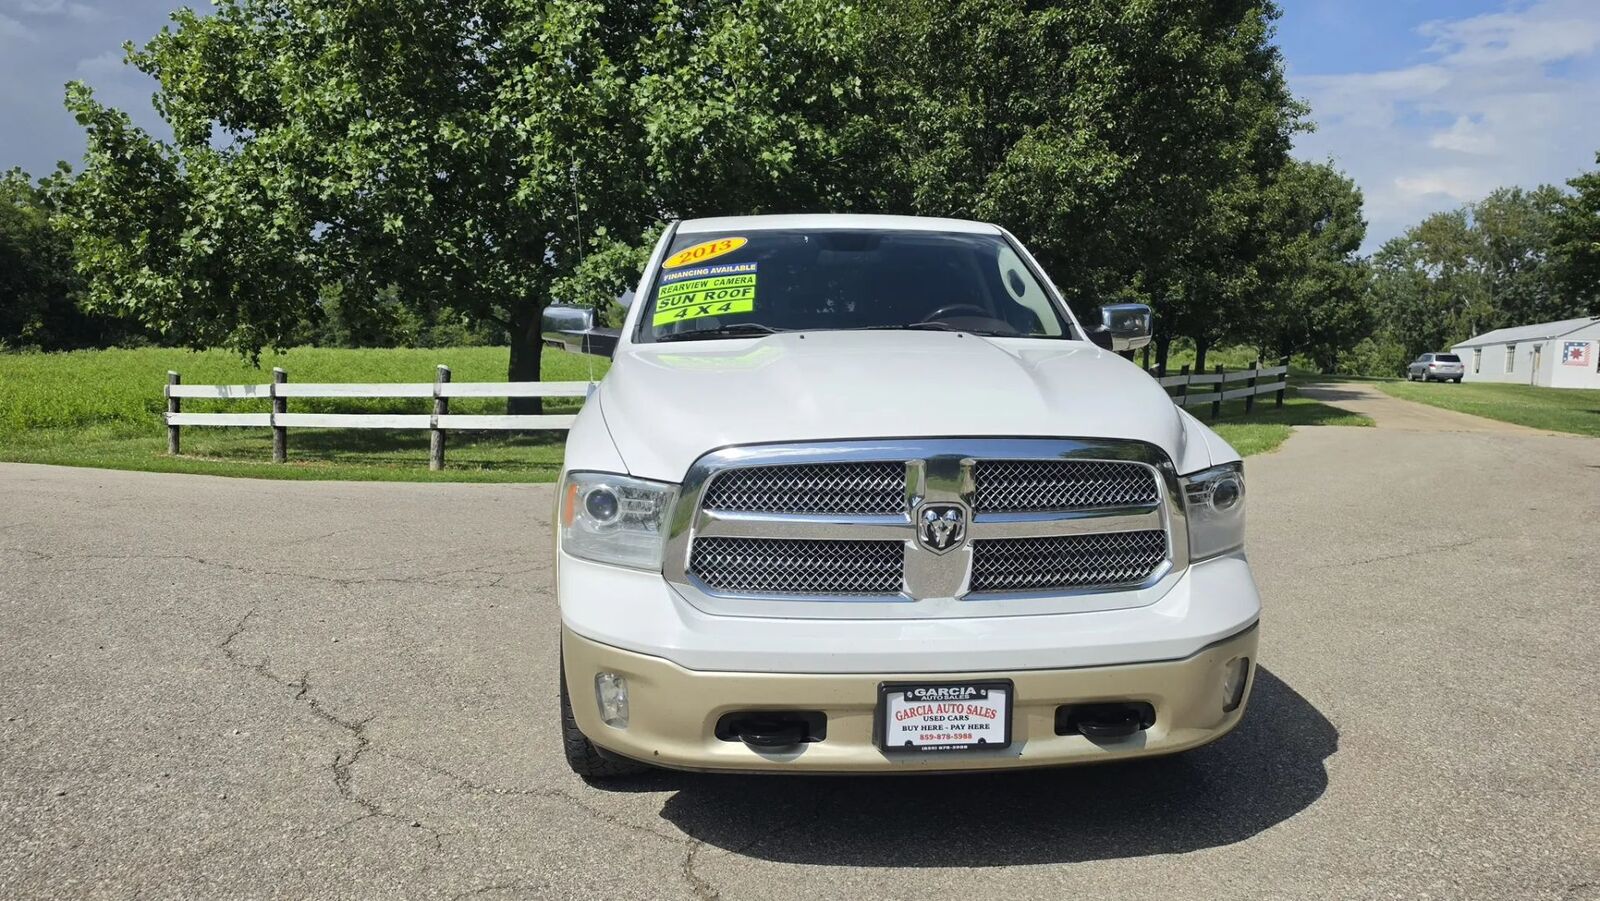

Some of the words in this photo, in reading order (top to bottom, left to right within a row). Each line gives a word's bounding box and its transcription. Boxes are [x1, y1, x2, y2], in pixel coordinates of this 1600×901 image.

[679, 240, 732, 264] 2013
[664, 268, 709, 281] FINANCING
[710, 264, 756, 274] AVAILABLE
[660, 280, 708, 295] REARVIEW
[713, 276, 753, 286] CAMERA
[658, 293, 696, 309] SUN
[704, 288, 752, 300] ROOF
[673, 308, 688, 318] 4
[716, 302, 732, 312] 4
[914, 687, 977, 696] GARCIA
[895, 704, 933, 721] GARCIA
[936, 703, 964, 714] AUTO
[966, 704, 997, 720] SALES
